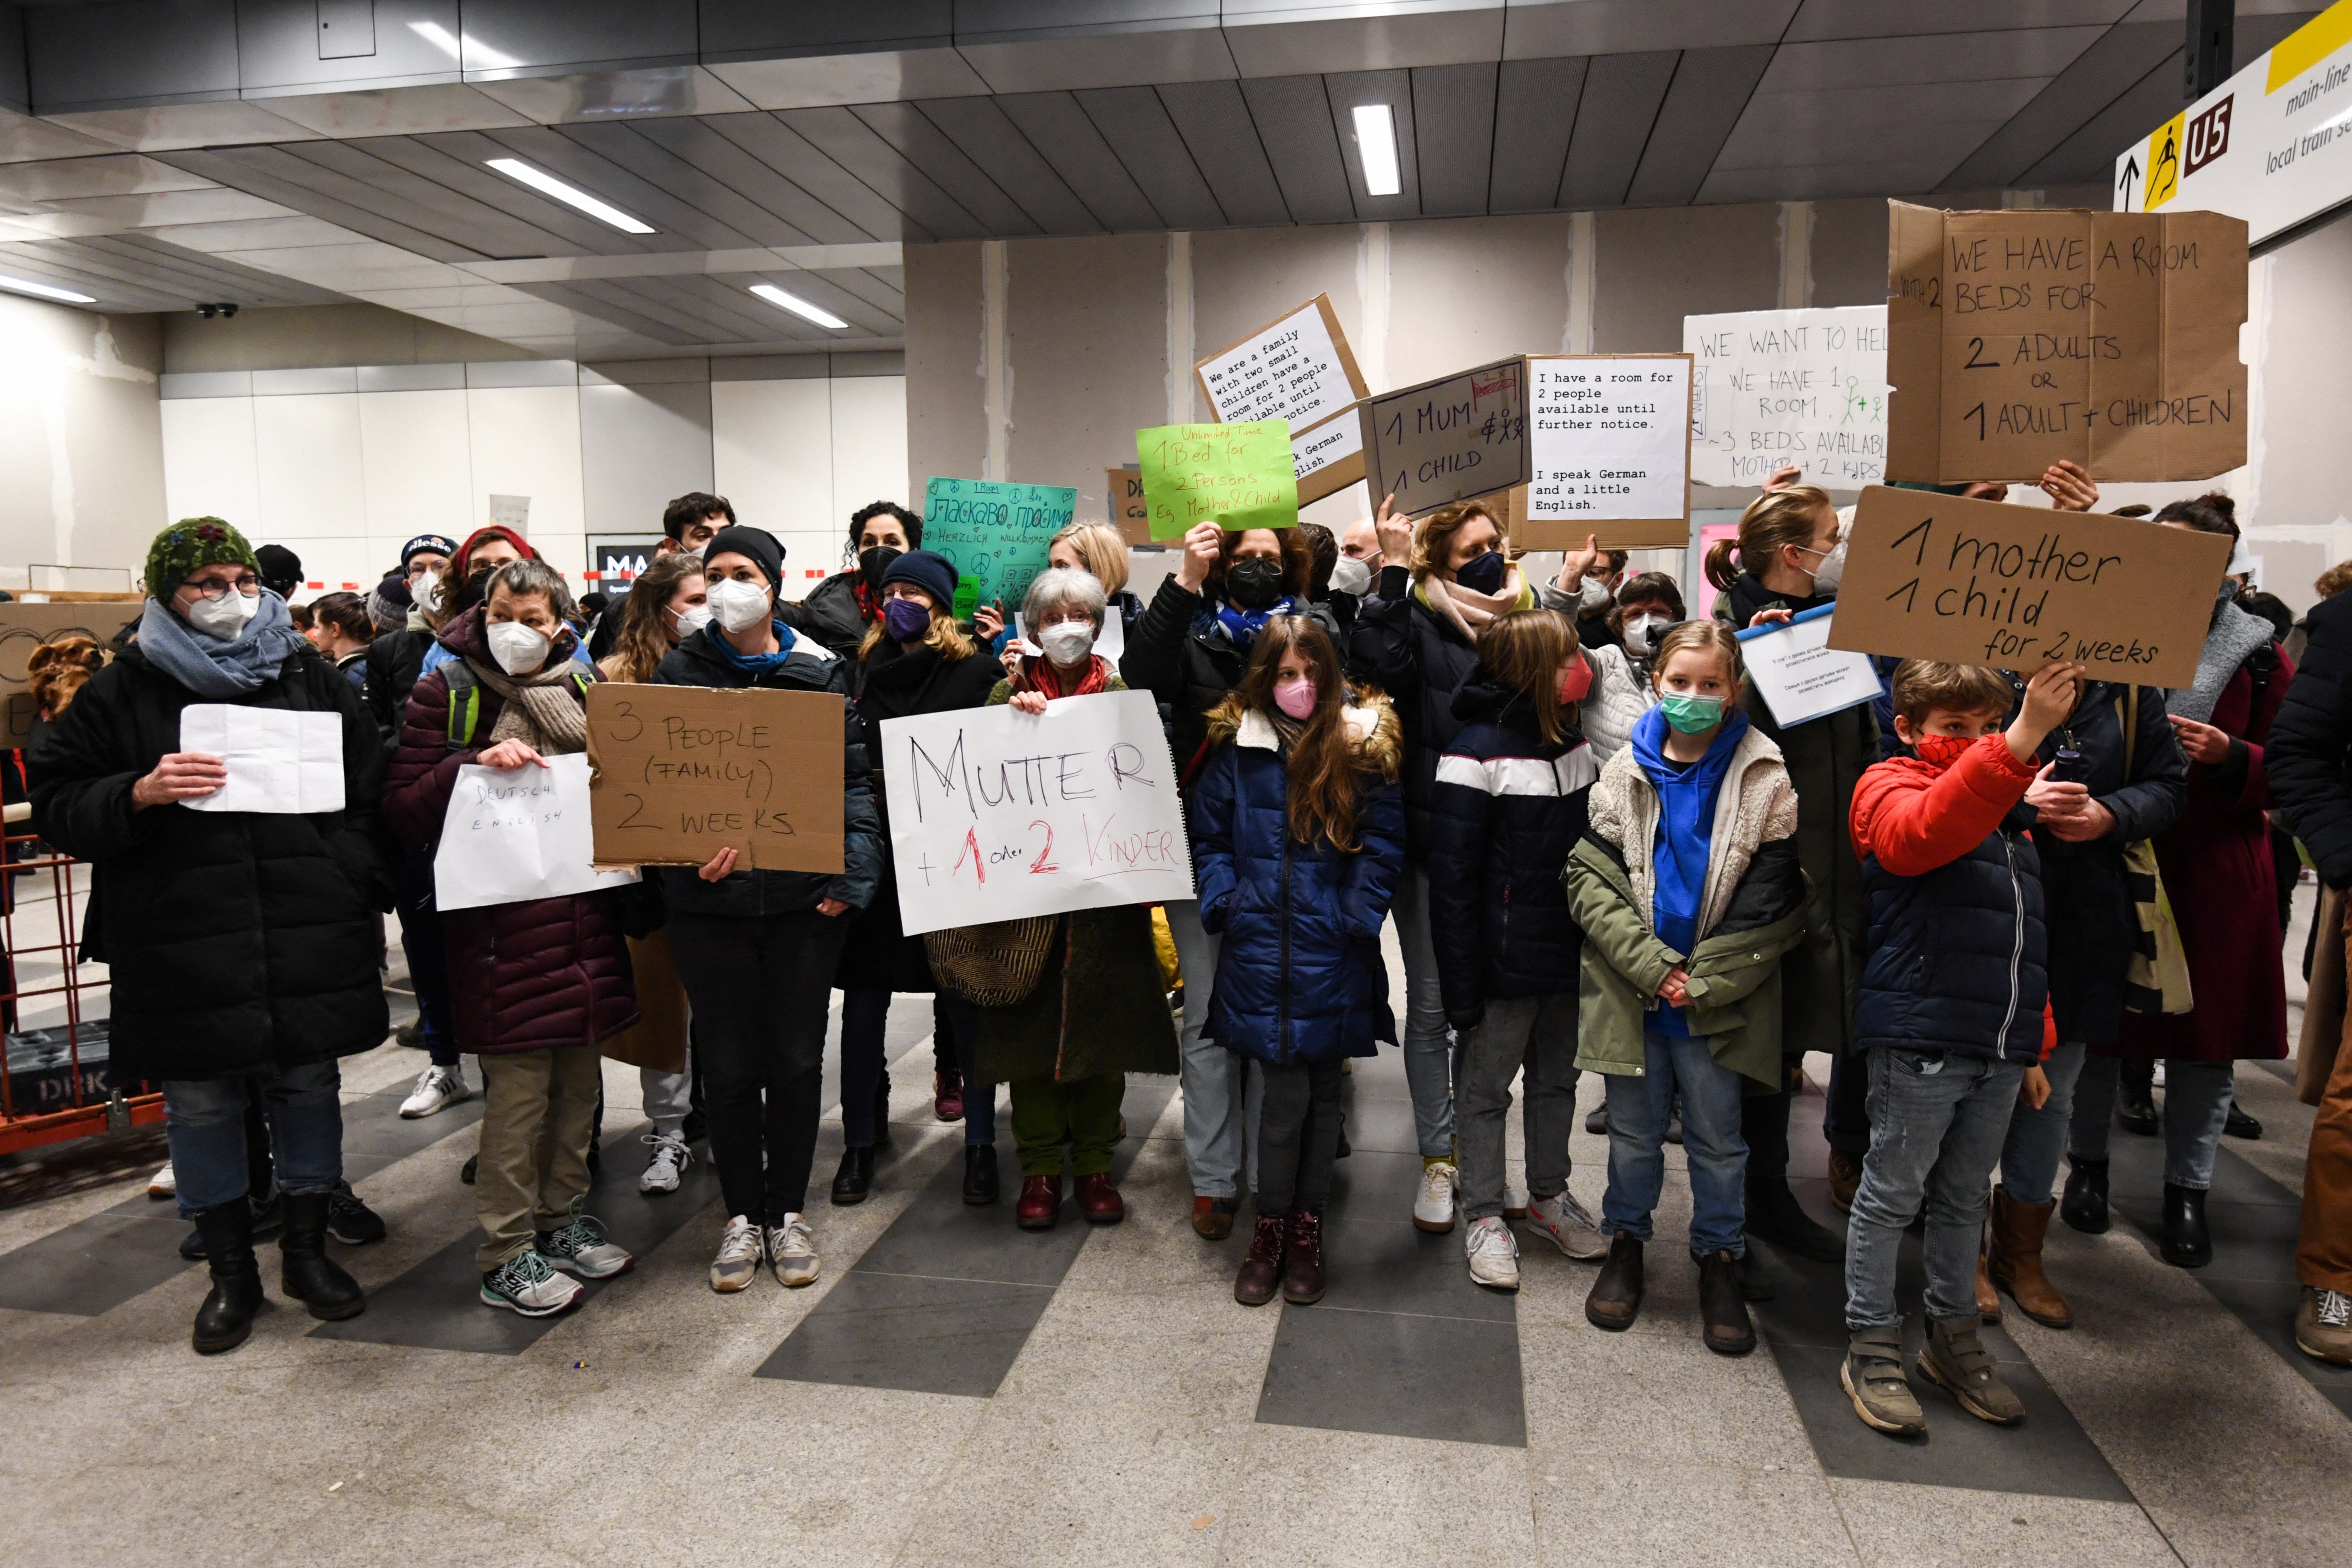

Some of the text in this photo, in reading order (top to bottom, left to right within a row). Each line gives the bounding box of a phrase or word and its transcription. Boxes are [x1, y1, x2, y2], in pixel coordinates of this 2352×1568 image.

[2286, 64, 2350, 117] main-line
[2190, 104, 2228, 165] U5
[2266, 138, 2296, 175] local
[2301, 127, 2332, 157] train
[1952, 236, 2198, 276] WE HAVE A ROOM
[1929, 277, 1941, 309] 2
[1956, 282, 2031, 313] BEDS
[2048, 283, 2107, 310] FOR
[1209, 373, 1222, 384] We
[1228, 360, 1246, 373] are
[1262, 330, 1298, 354] family
[1701, 326, 1887, 357] WE WANT TO HEL
[1964, 334, 2120, 369] 2 ADULTS
[1215, 346, 1298, 396] with two small
[1221, 378, 1268, 408] children
[1273, 363, 1298, 380] have
[1539, 374, 1546, 383] I
[1555, 373, 1586, 383] have
[1651, 373, 1673, 382] for
[1730, 366, 1840, 391] WE HAVE 1
[2031, 372, 2057, 389] OR
[1227, 363, 1328, 421] room for 2 people
[1245, 381, 1321, 422] ilable until
[1539, 389, 1601, 401] 2 people
[1283, 400, 1325, 421] notice.
[1386, 412, 1402, 445] 1
[1417, 401, 1470, 434] MUM
[1538, 404, 1655, 413] available until
[1538, 419, 1654, 429] further notice.
[1964, 402, 1985, 441] 1
[1997, 402, 2081, 434] ADULT
[2083, 409, 2098, 427] +
[1182, 425, 1263, 441] Unlimited Time
[1306, 432, 1343, 455] German
[1751, 431, 1806, 451] BEDS
[1817, 431, 1886, 458] AVAILABL
[1153, 439, 1248, 470] 1 Bed for
[1294, 457, 1324, 478] glish
[1801, 461, 1810, 472] +
[1820, 459, 1834, 475] 2
[1843, 461, 1880, 478] KIDS
[974, 483, 978, 491] 1
[1176, 473, 1257, 490] 2 Persons
[1392, 451, 1481, 492] 1 CHILD
[1537, 470, 1646, 481] I speak German
[1536, 485, 1560, 494] and
[1584, 484, 1630, 493] little
[1157, 504, 1174, 523] Eg
[1188, 496, 1229, 517] Mother
[1244, 489, 1280, 507] Child
[1536, 501, 1596, 512] English.
[408, 538, 451, 552] ellesse
[938, 528, 987, 546] HERZLICH
[1891, 517, 2122, 585] 1 mother
[955, 600, 975, 609] Bed
[1886, 576, 2050, 627] 1 child
[1985, 629, 2159, 664] for 2 weeks
[1785, 682, 1800, 691] Семья
[610, 702, 770, 758] 3 PEOPLE
[476, 785, 550, 806] DEUTSCH
[617, 794, 795, 836] 2 WEEKS
[918, 852, 937, 886] +
[952, 825, 985, 890] 1
[1028, 820, 1060, 874] 2
